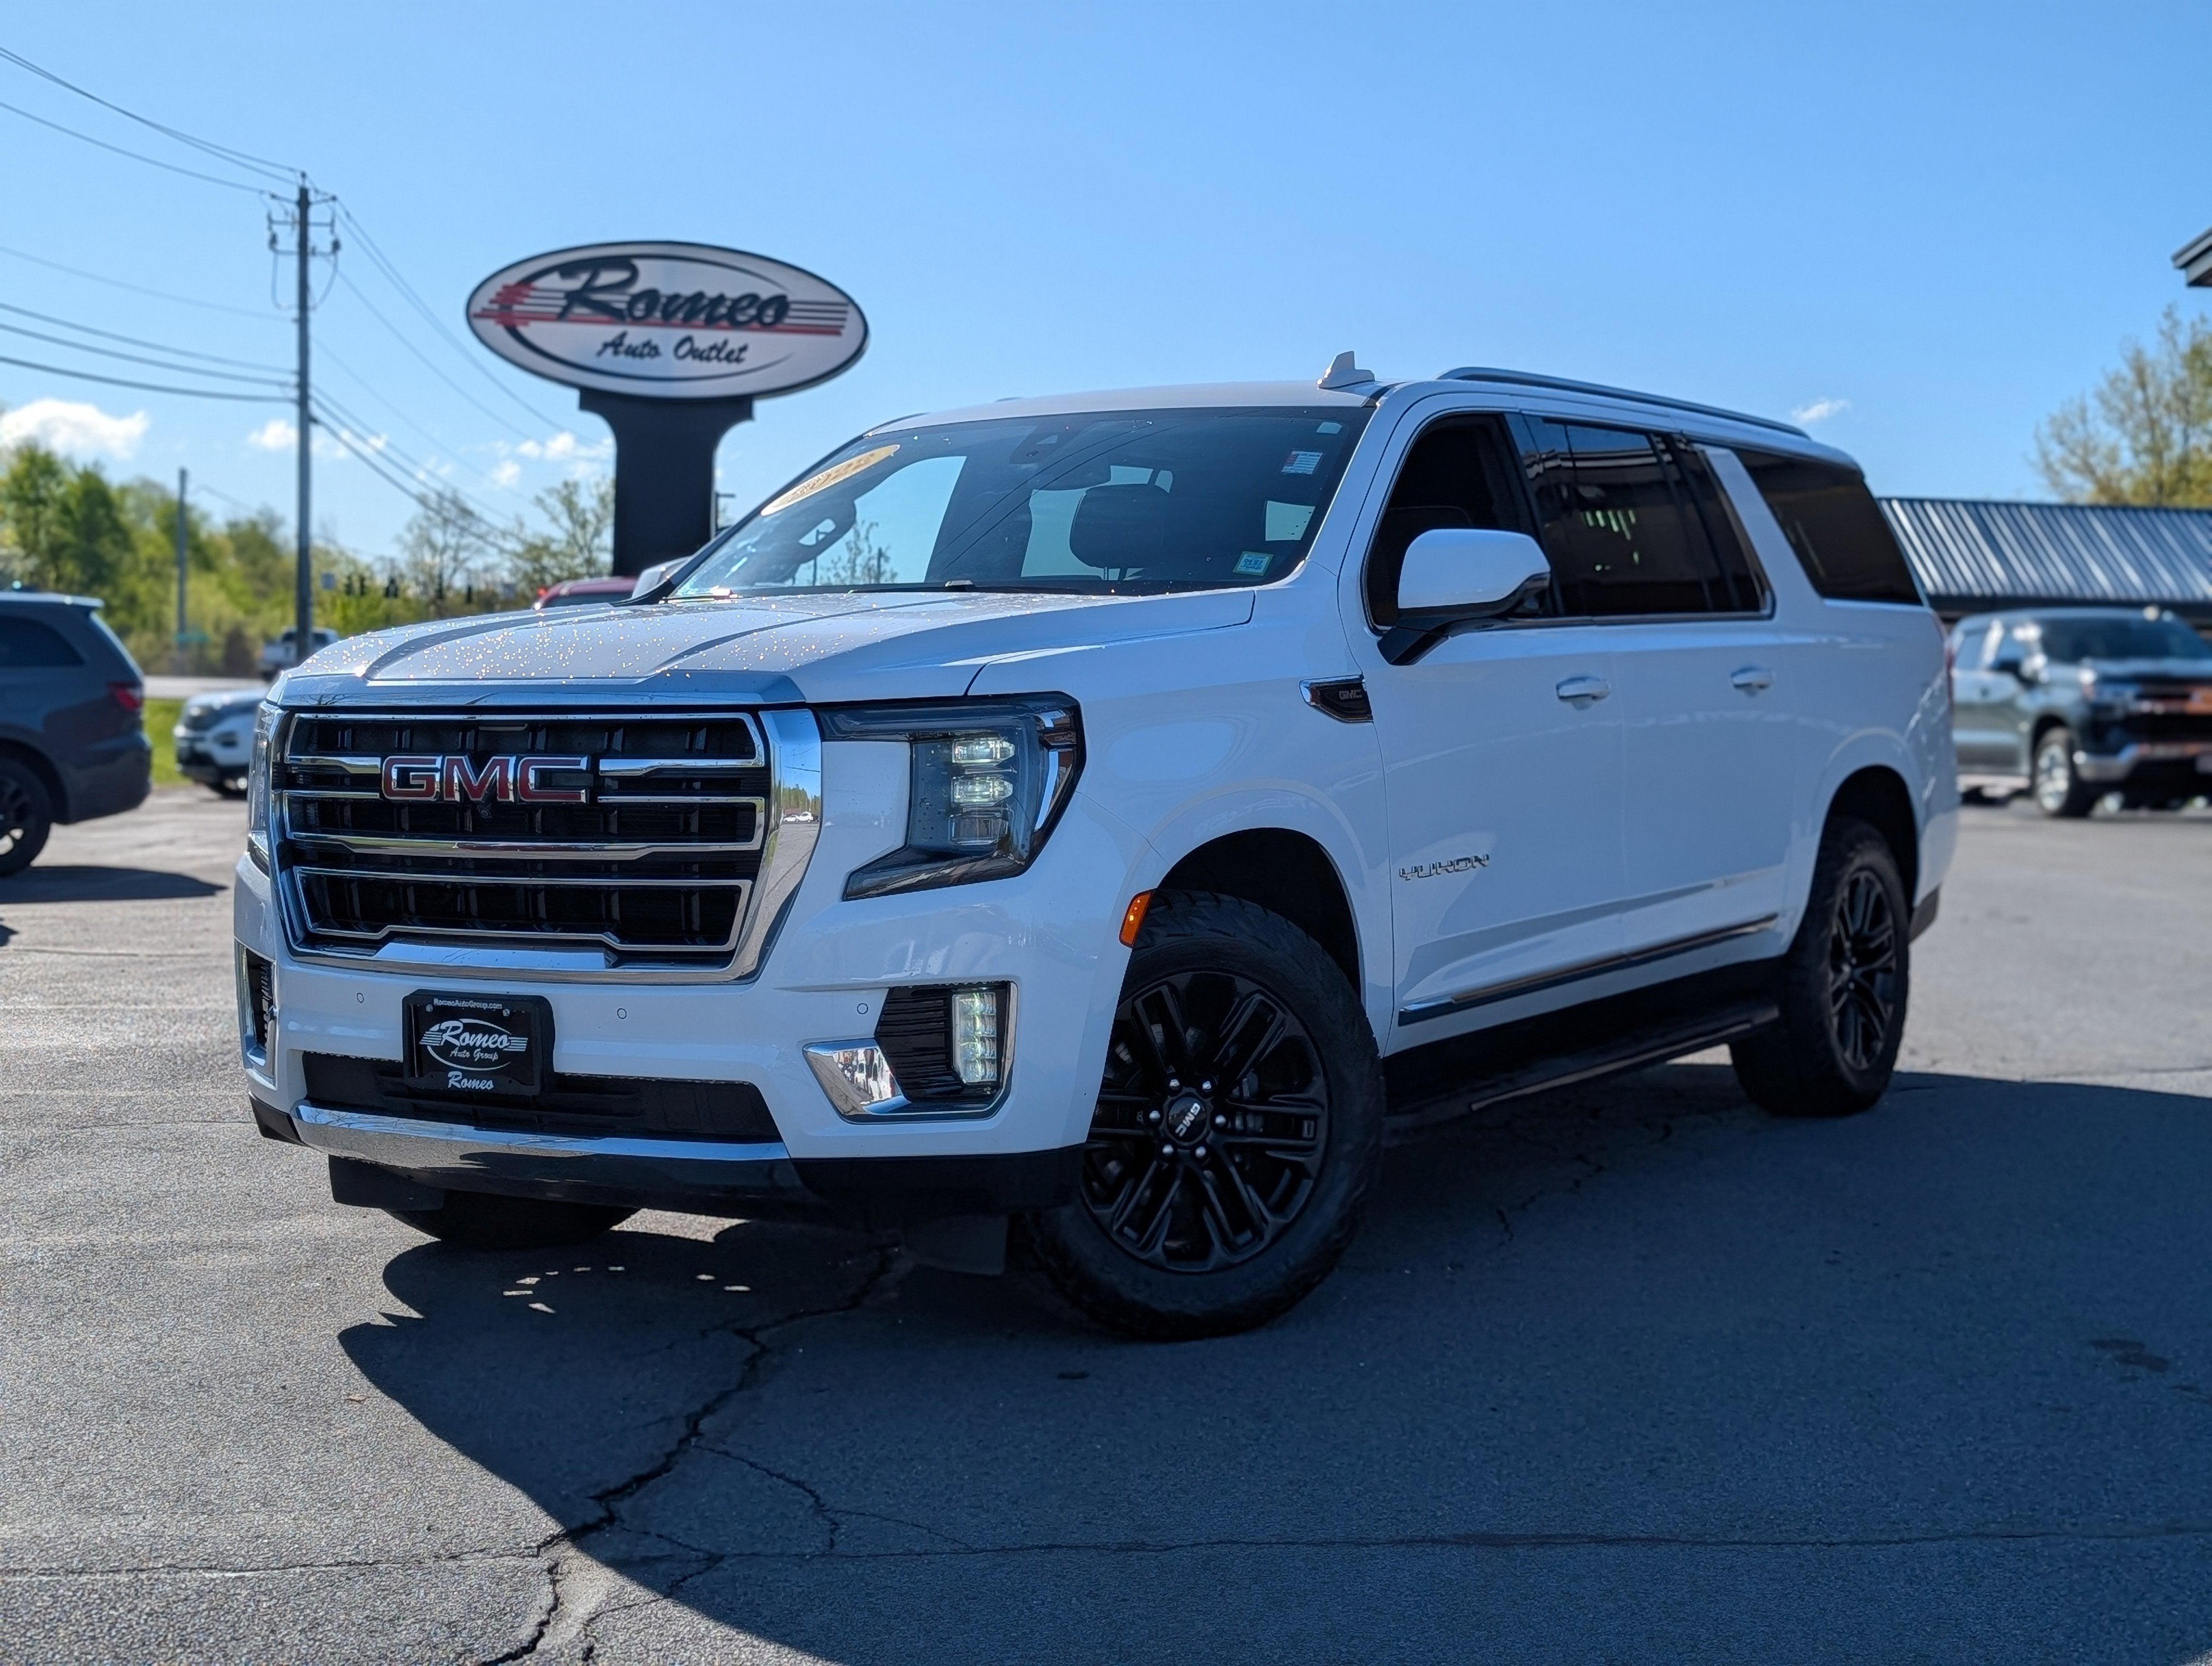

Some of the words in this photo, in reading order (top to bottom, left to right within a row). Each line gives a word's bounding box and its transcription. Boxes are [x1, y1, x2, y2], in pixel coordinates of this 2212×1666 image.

[556, 257, 790, 326] Romeo
[596, 330, 662, 358] Auto
[672, 334, 750, 364] Outlet
[1339, 689, 1363, 700] GMC
[382, 755, 590, 803] GMC
[1398, 853, 1490, 881] YUKON
[439, 1020, 511, 1049] Romeo
[449, 1047, 471, 1059] Auto
[473, 1049, 499, 1062] Group
[447, 1071, 494, 1091] Romeo
[1175, 1103, 1201, 1137] GMC
